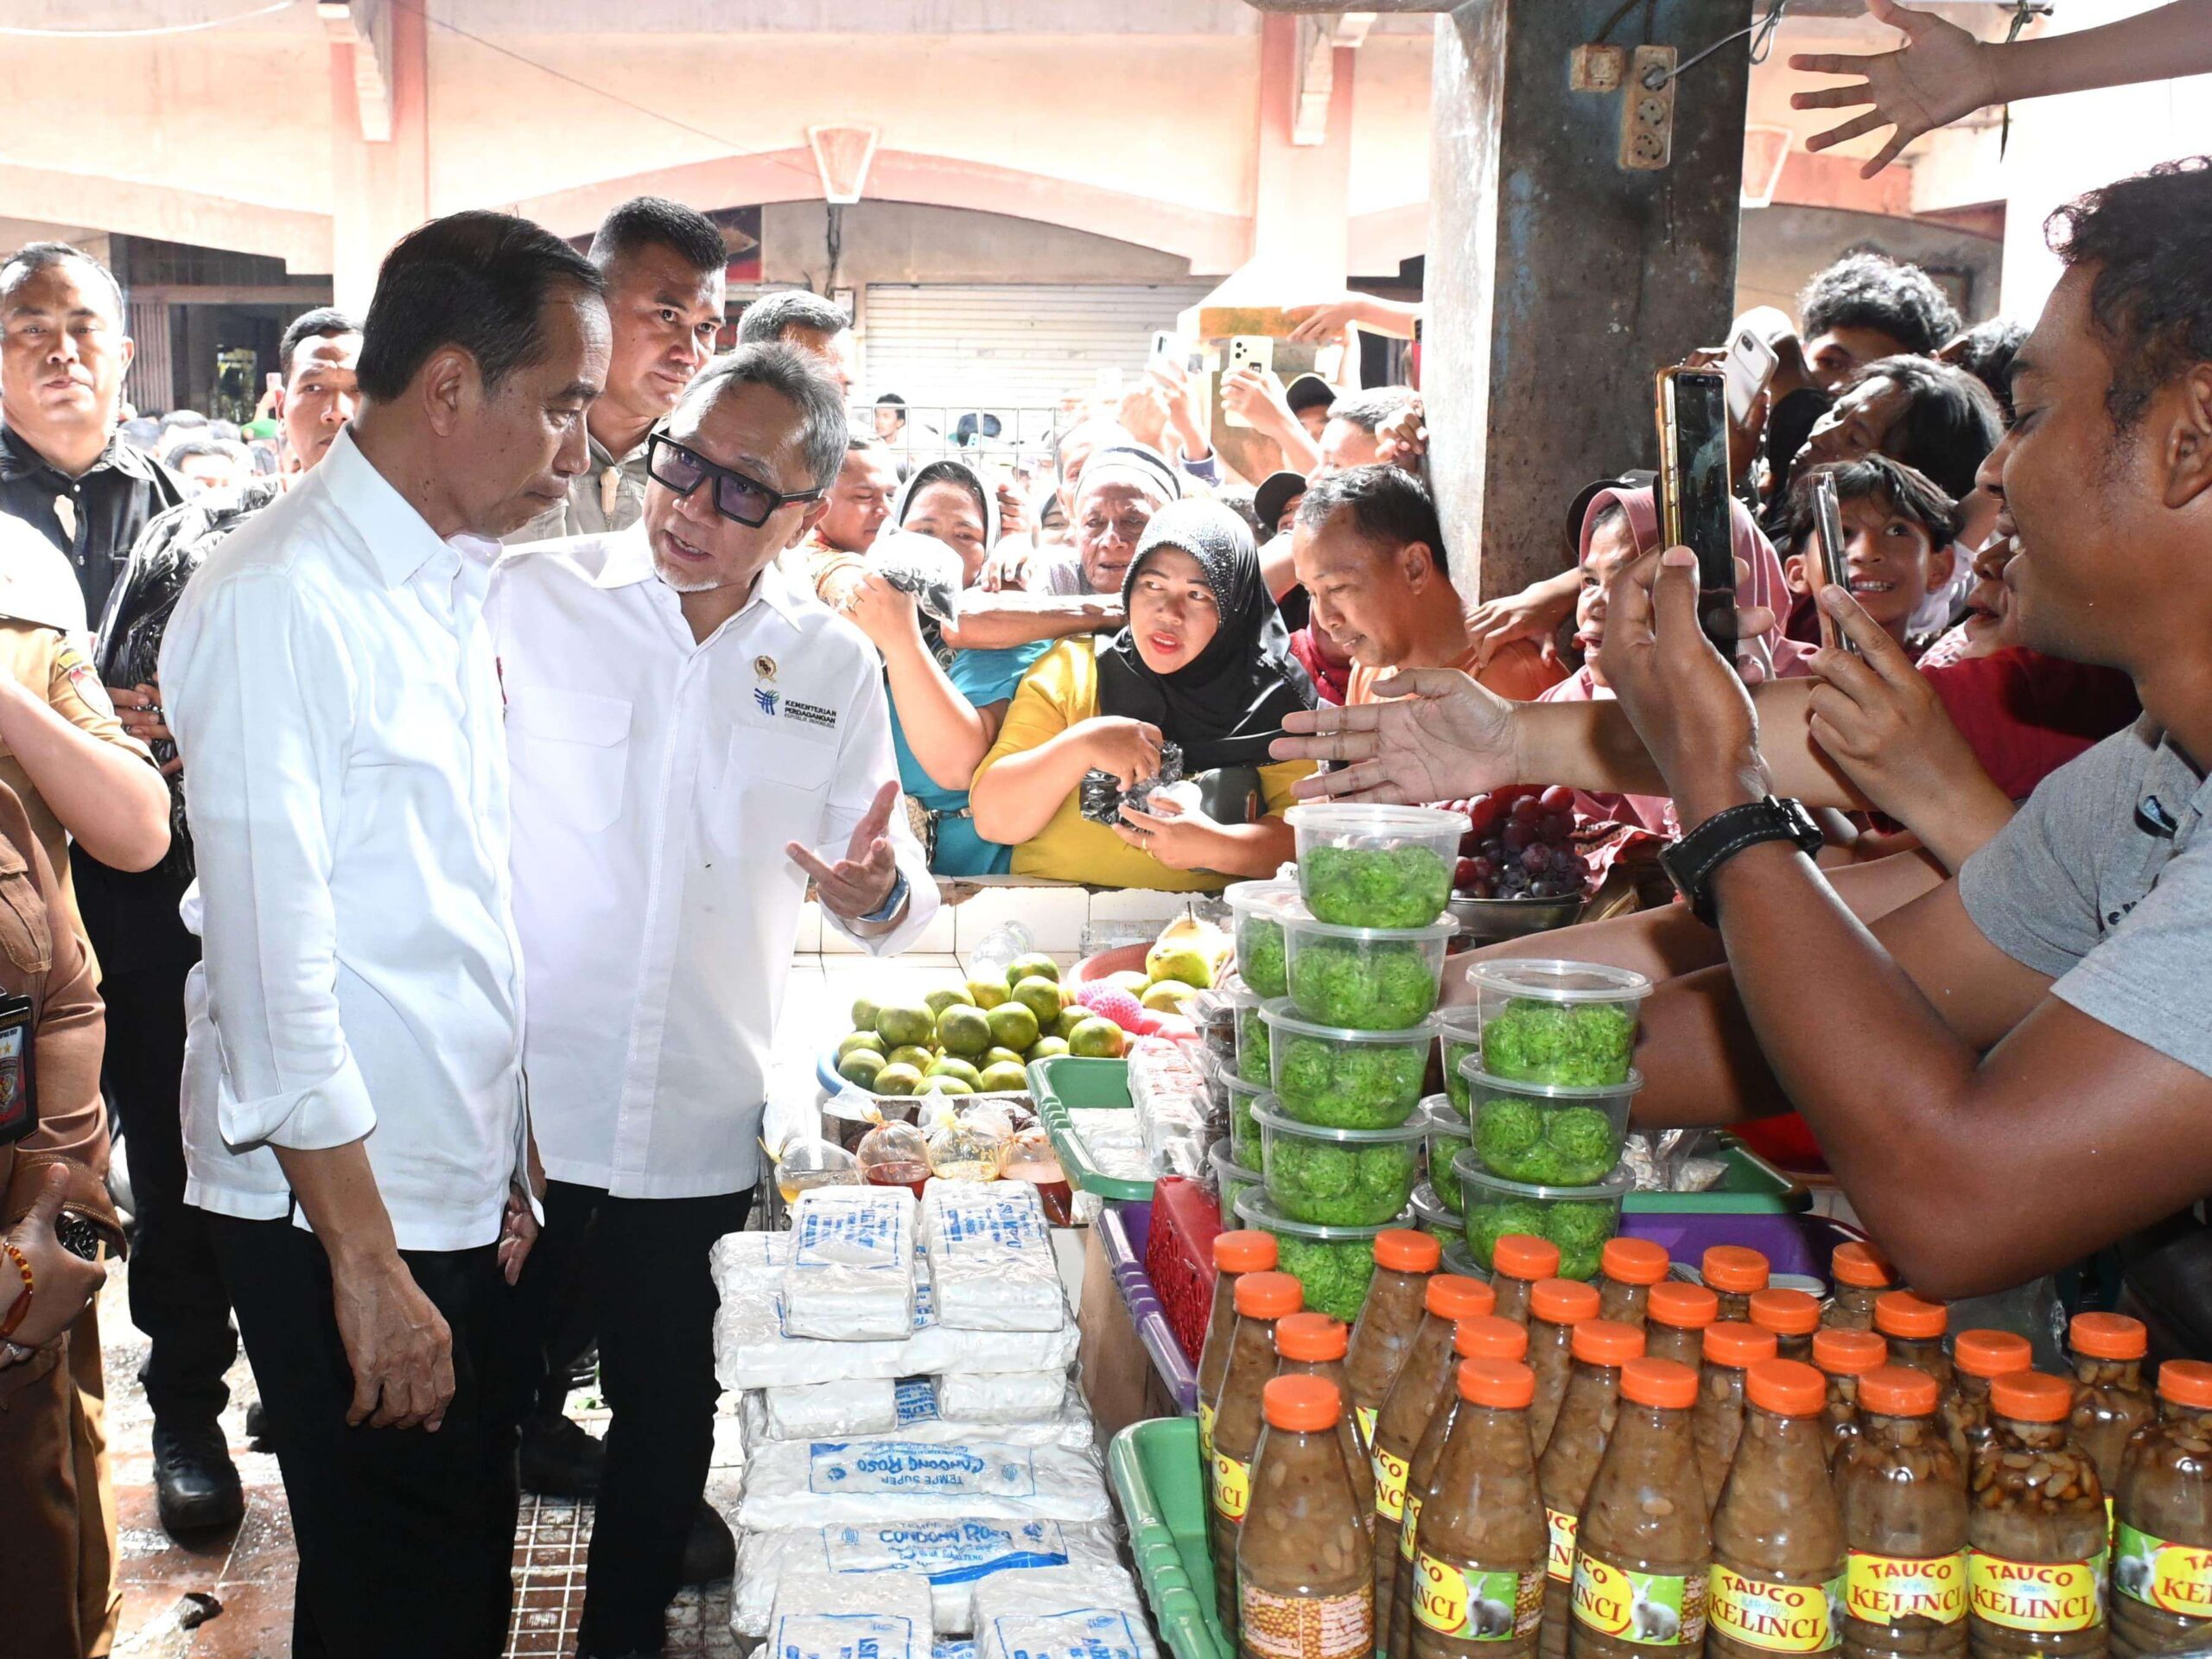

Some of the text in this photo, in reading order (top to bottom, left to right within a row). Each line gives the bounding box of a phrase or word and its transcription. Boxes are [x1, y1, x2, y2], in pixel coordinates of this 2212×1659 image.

[785, 701, 836, 716] KEMENTERIAN
[785, 709, 835, 723] PERDAGANGAN
[880, 1475, 963, 1485] TEMPE SUPER
[1867, 1563, 1952, 1580] TAUCO
[1986, 1565, 2074, 1587] TAUCO
[1721, 1575, 1805, 1607] TAUCO
[1851, 1585, 1962, 1612] KELINCI
[1973, 1583, 2089, 1619] KELINCI
[1710, 1592, 1821, 1639] KELINCI
